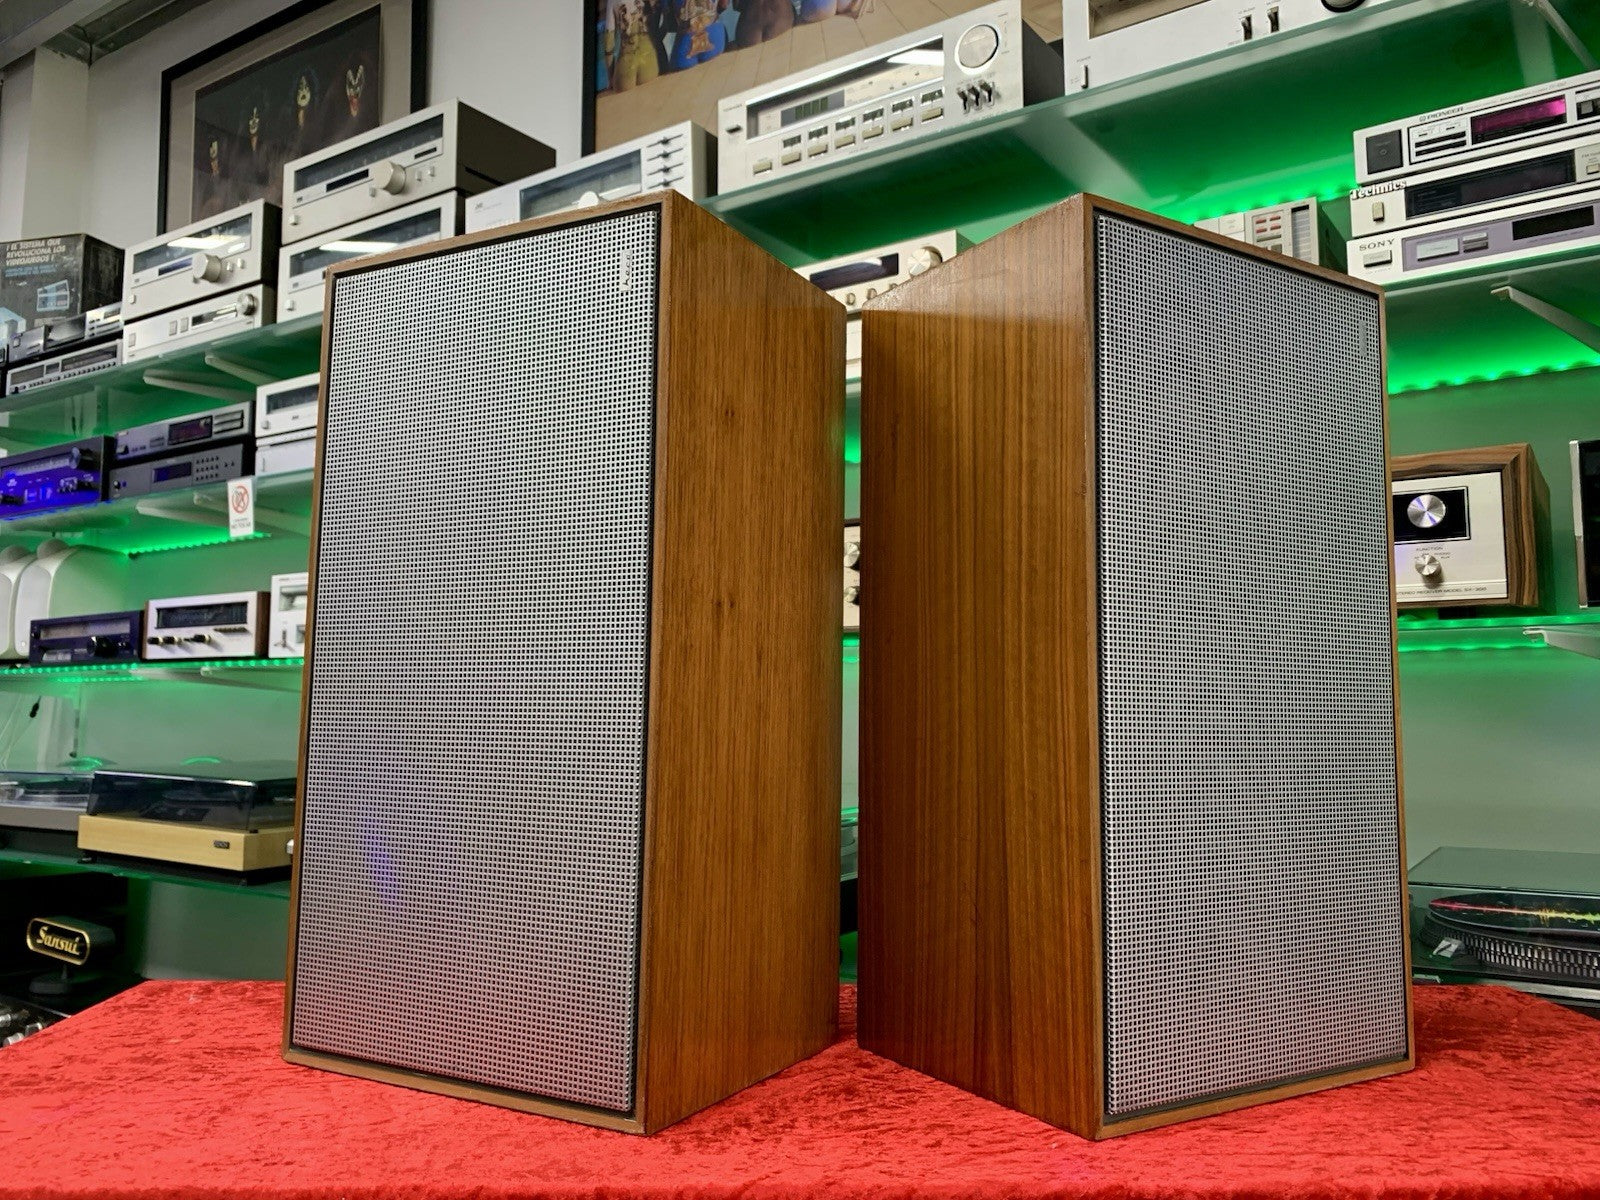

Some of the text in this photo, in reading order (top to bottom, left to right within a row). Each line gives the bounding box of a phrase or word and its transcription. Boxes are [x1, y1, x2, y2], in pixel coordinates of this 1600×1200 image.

[1350, 181, 1407, 200] Technics
[6, 245, 66, 259] REVOLUCIONA LOS
[1360, 238, 1395, 251] SONY
[36, 926, 80, 956] Sansui
